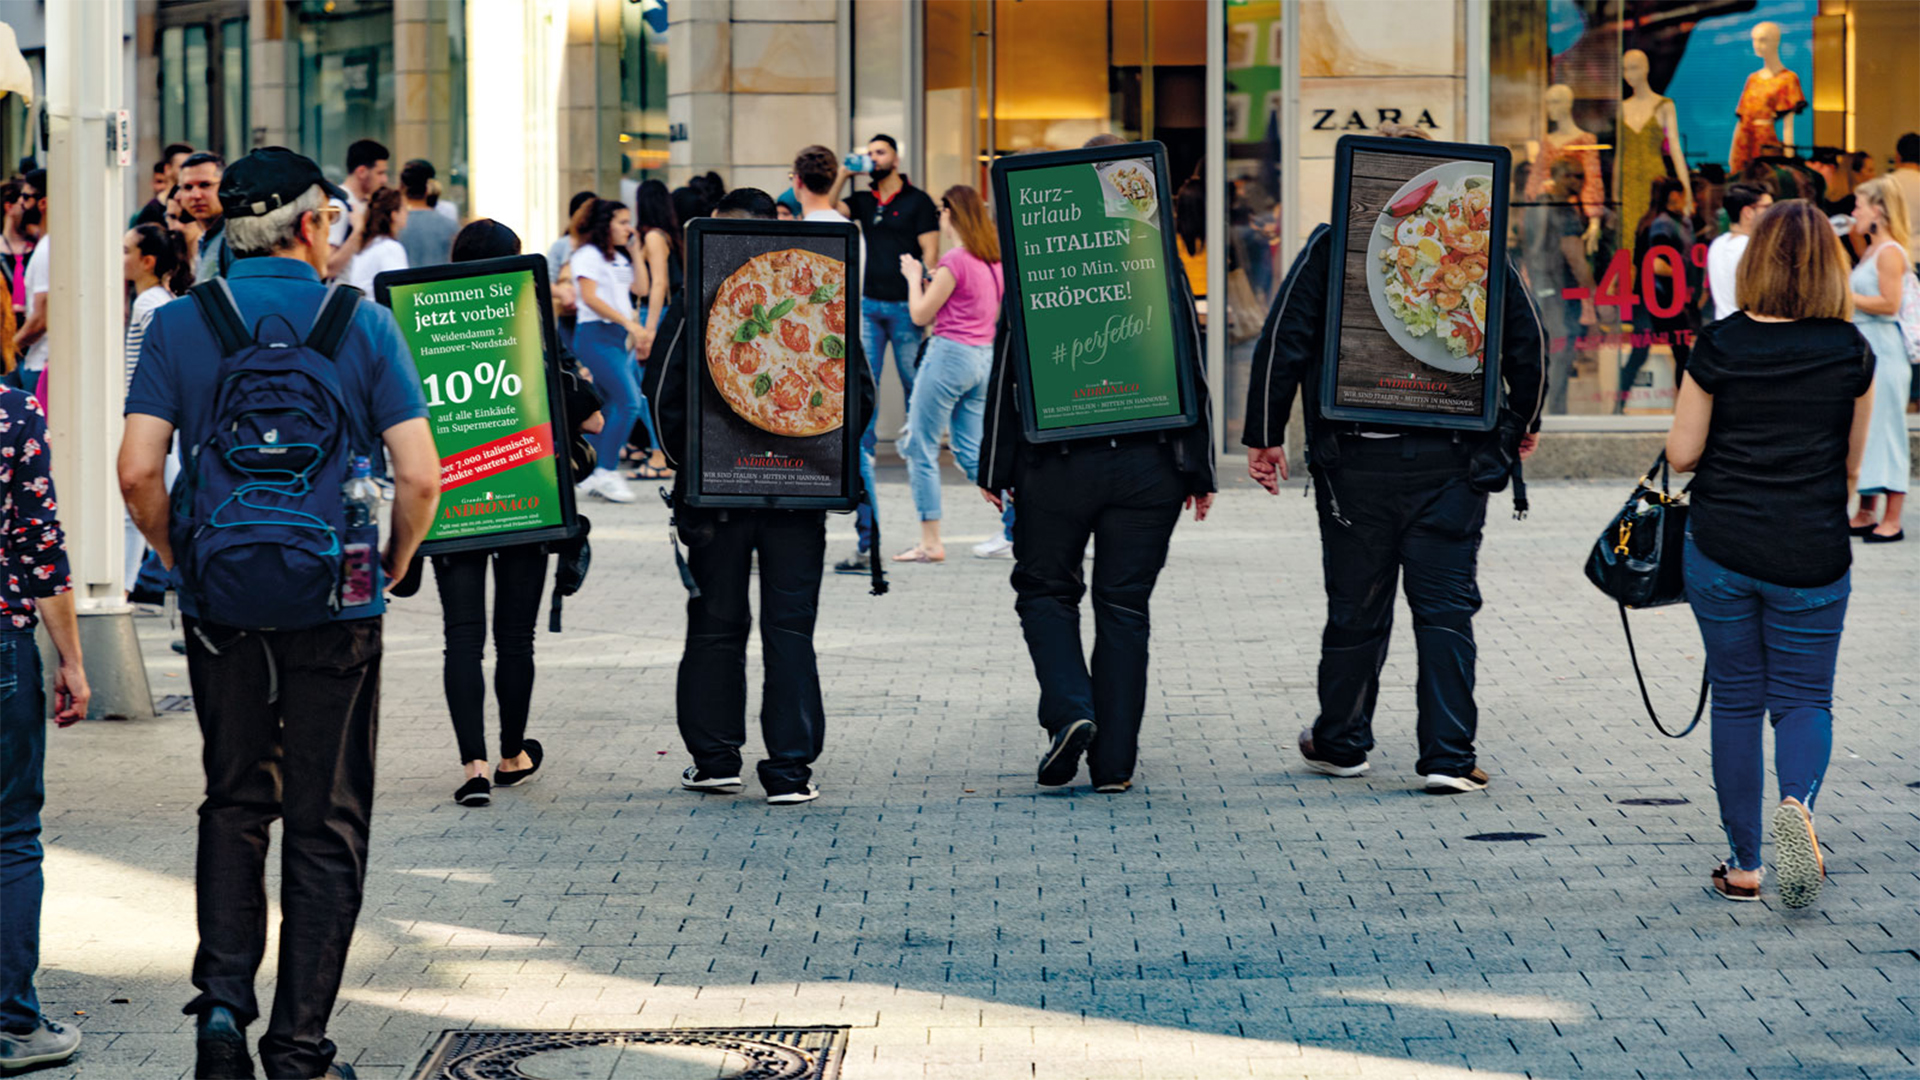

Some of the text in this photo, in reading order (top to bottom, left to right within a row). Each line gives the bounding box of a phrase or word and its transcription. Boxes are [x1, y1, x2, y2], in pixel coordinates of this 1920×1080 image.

[1312, 109, 1440, 130] ZARA
[1019, 187, 1073, 205] Kurz-
[1022, 203, 1082, 226] urlaub
[1024, 241, 1041, 256] in
[1046, 229, 1131, 254] ITALIEN
[1027, 257, 1155, 282] nur 10 Min. vom
[413, 283, 513, 306] Kommen Sie
[1030, 281, 1132, 310] KRÖPCKE!
[415, 301, 515, 332] jetzt vorbei!
[431, 327, 504, 343] Weidendamm 2
[420, 336, 517, 356] Hannover-Nordstadt
[423, 359, 522, 407] 10%
[1073, 383, 1139, 399] ANDRONACO
[1378, 377, 1448, 392] ANDRONACO
[1072, 403, 1097, 411] ITALIEN
[1101, 400, 1125, 408] MITTEN
[1374, 392, 1400, 401] ITALIEN
[438, 404, 516, 422] auf alle Einkäufe
[437, 425, 449, 435] im
[455, 454, 481, 469] 7.000
[482, 436, 535, 459] italienische
[474, 457, 508, 473] warten
[508, 448, 523, 462] auf
[524, 442, 542, 456] Sie!
[735, 456, 804, 468] ANDRONACO
[442, 496, 539, 519] ANDRONACO
